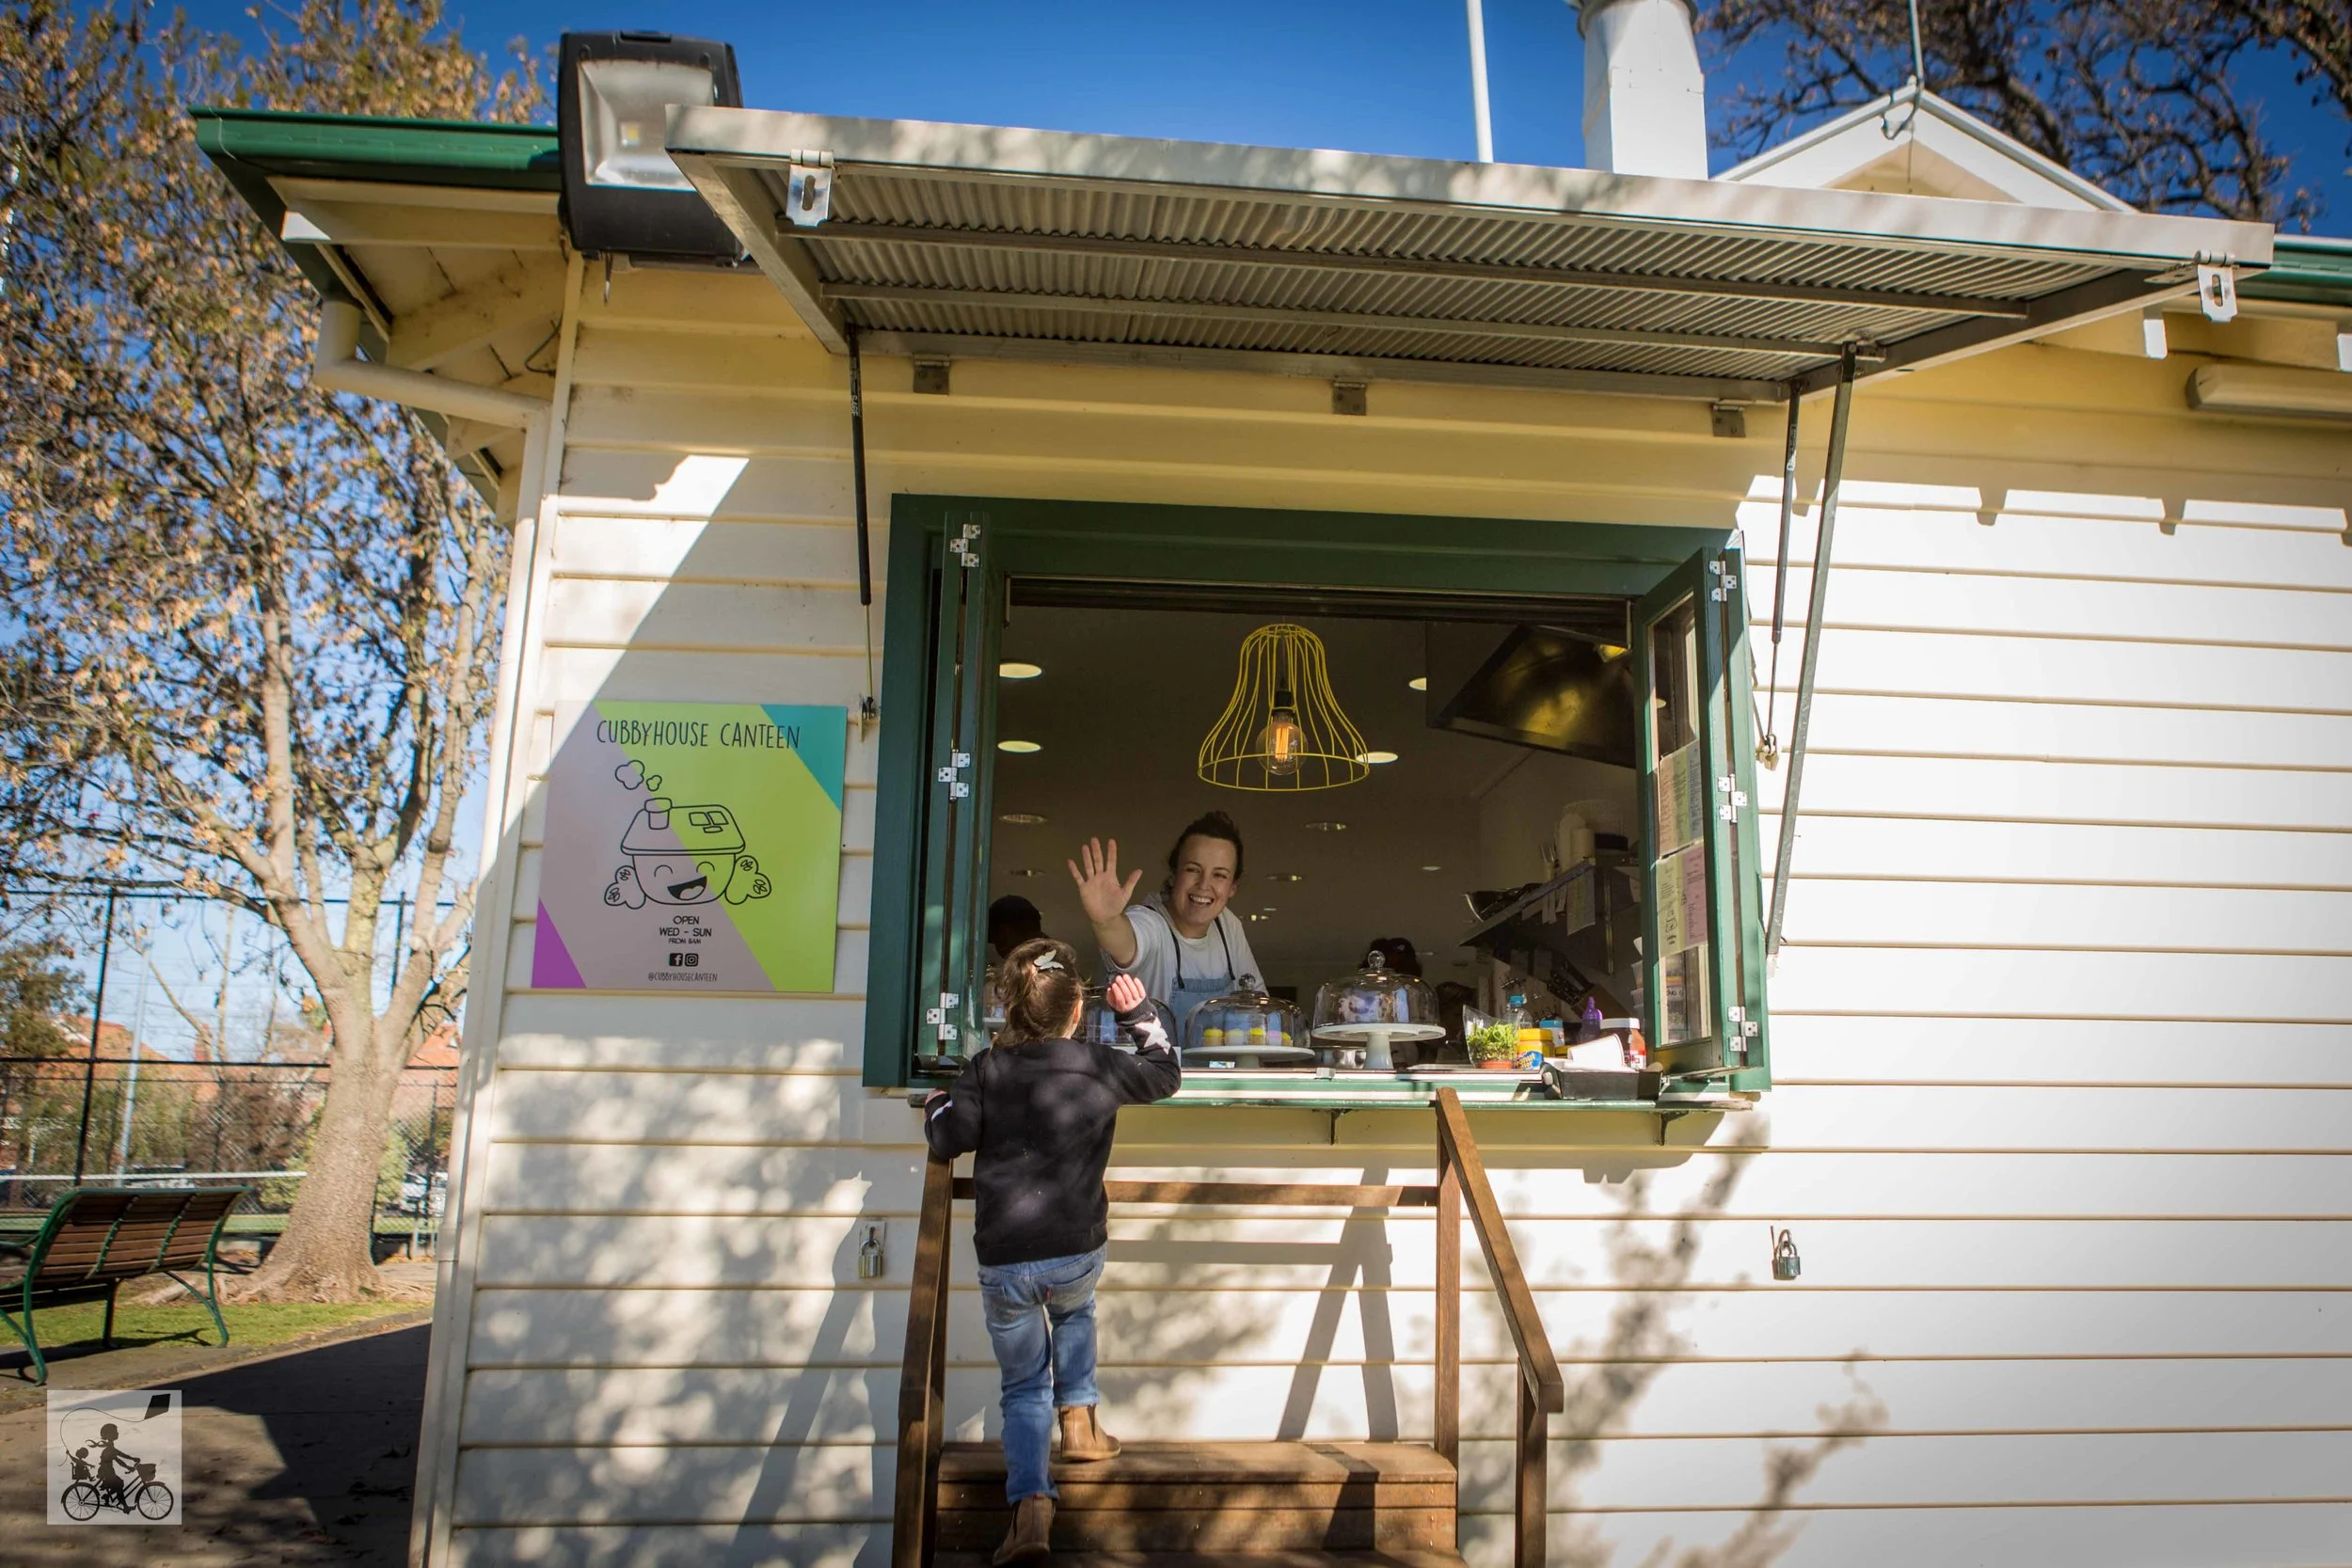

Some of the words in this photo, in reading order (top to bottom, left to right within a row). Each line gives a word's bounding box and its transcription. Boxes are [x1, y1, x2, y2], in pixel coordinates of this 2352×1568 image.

[596, 720, 709, 747] CUBBYHOUSE
[720, 722, 801, 749] CANTEEN
[673, 915, 700, 925] OPEN
[660, 927, 680, 937] WED
[692, 927, 712, 937] SUN
[647, 972, 718, 982] @CUBBYHOUSECANTEEN
